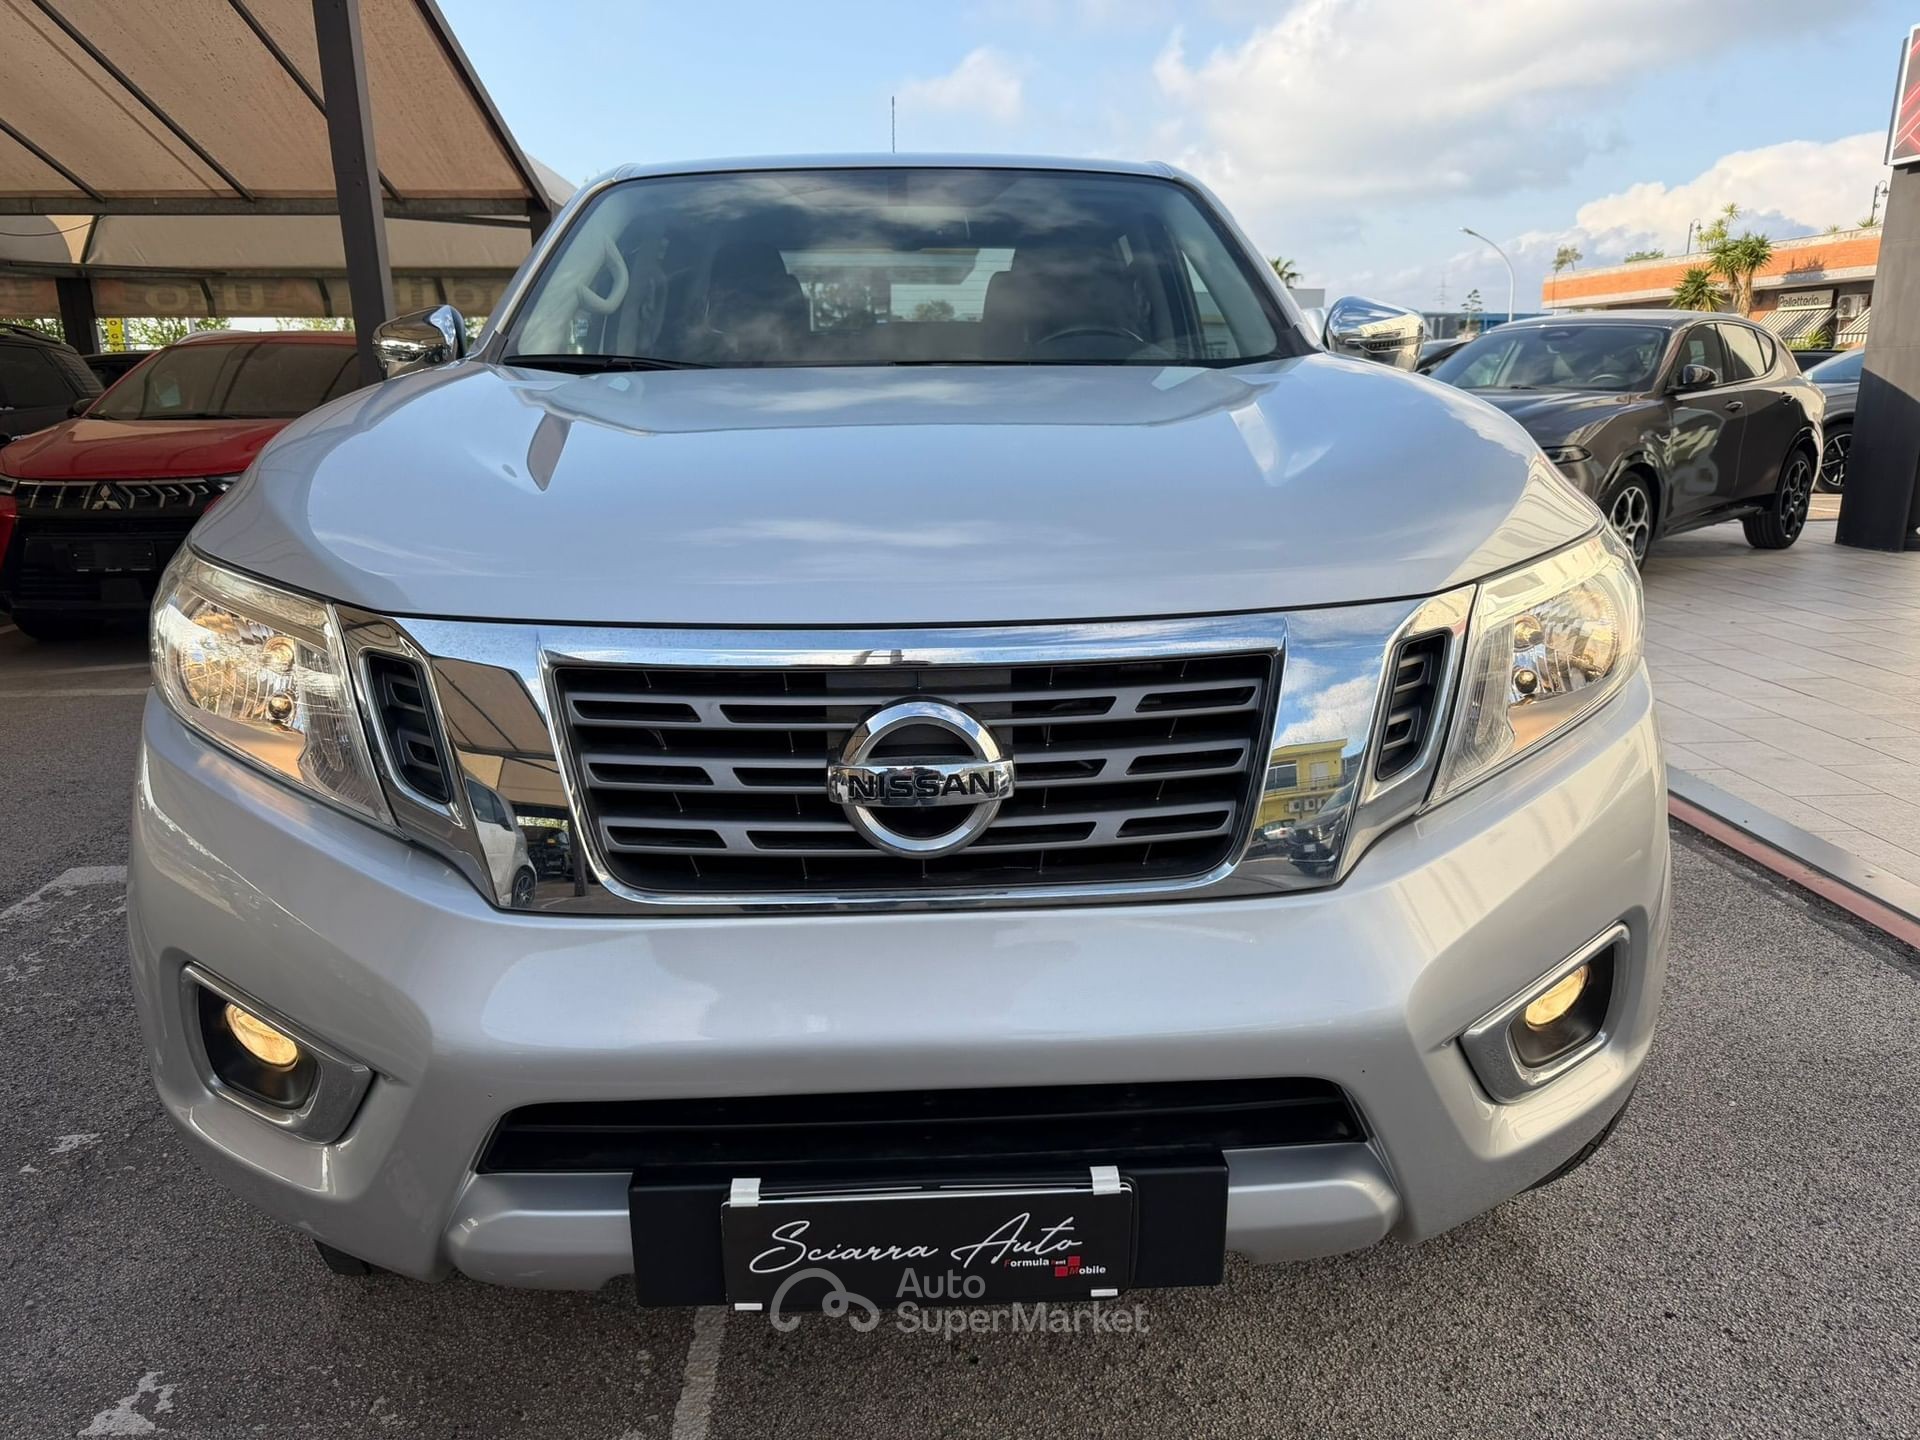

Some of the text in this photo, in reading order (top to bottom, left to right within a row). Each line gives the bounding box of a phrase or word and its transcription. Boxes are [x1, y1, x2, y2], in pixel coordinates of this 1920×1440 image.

[848, 770, 996, 798] NISSAN
[749, 1212, 1083, 1273] Sciarra Auto
[1003, 1257, 1050, 1268] Formula
[1069, 1265, 1106, 1276] Mobile
